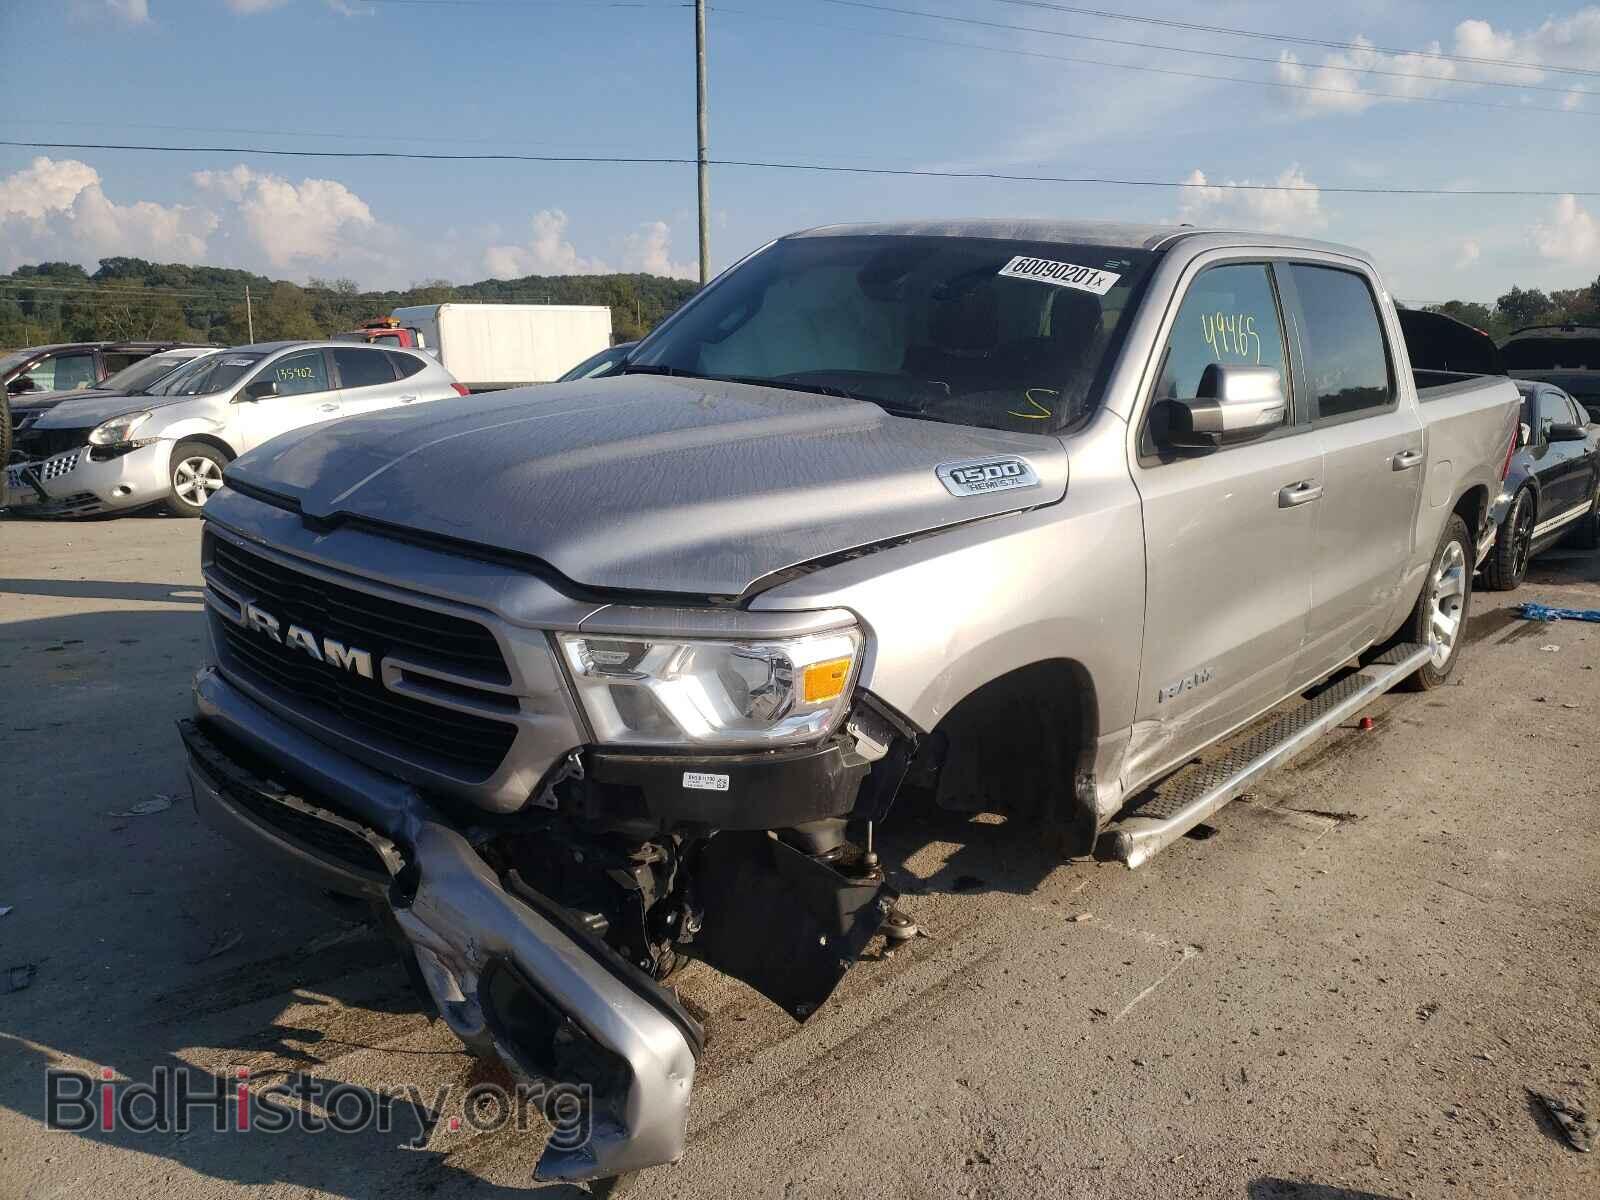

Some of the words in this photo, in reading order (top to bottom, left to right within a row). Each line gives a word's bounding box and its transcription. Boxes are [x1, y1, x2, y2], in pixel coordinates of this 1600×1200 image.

[950, 462, 1026, 484] 1500
[968, 480, 999, 491] HEMI
[239, 601, 374, 680] RAM
